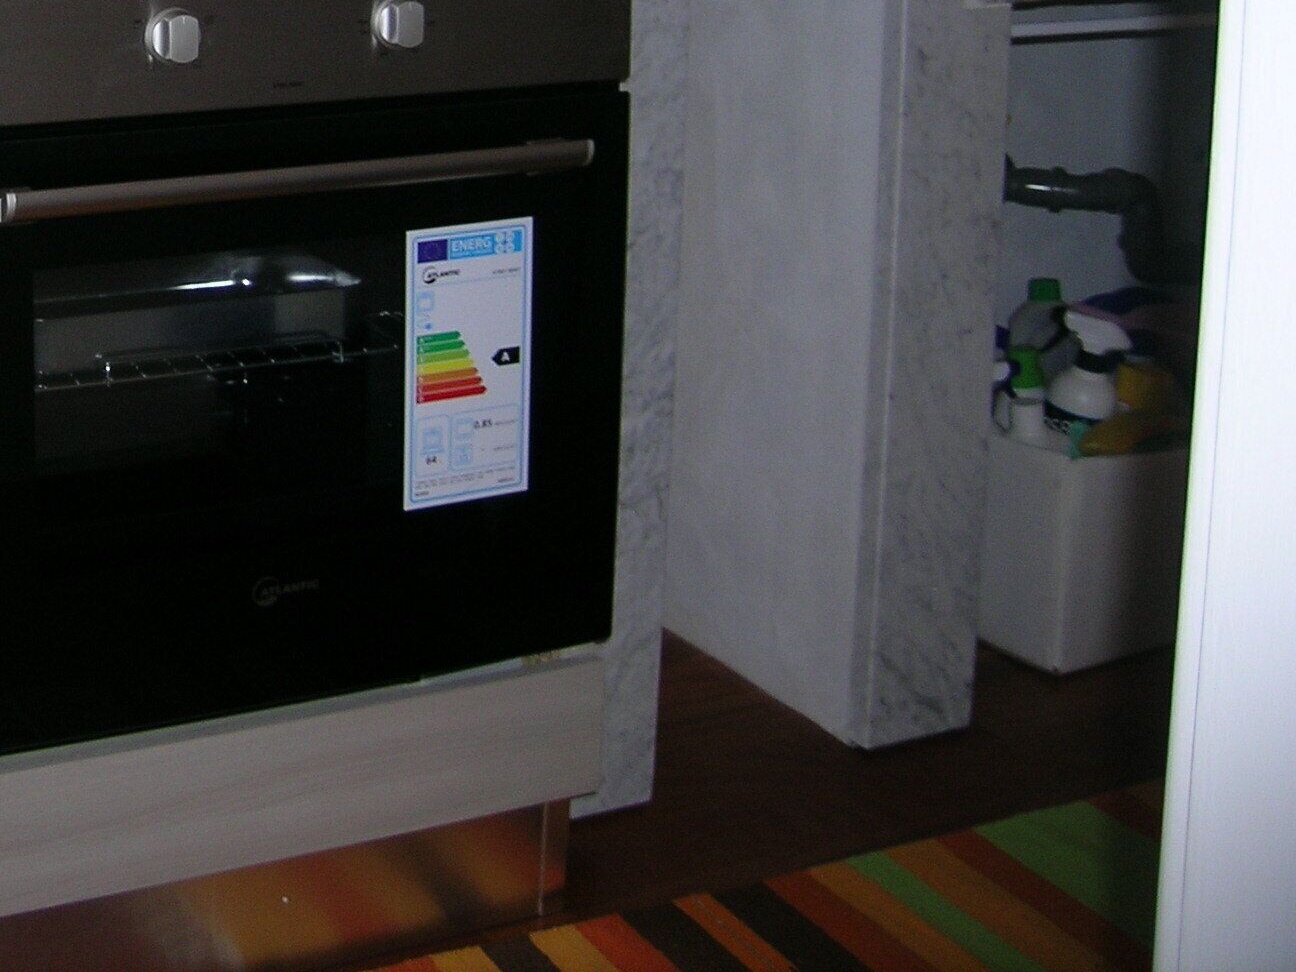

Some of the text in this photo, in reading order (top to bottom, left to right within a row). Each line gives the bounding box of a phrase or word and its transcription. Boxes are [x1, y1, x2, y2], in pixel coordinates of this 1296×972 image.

[452, 236, 491, 252] ENERG
[427, 268, 460, 279] ATLANTIC
[500, 351, 510, 362] A
[262, 578, 320, 595] ATLANTIC
